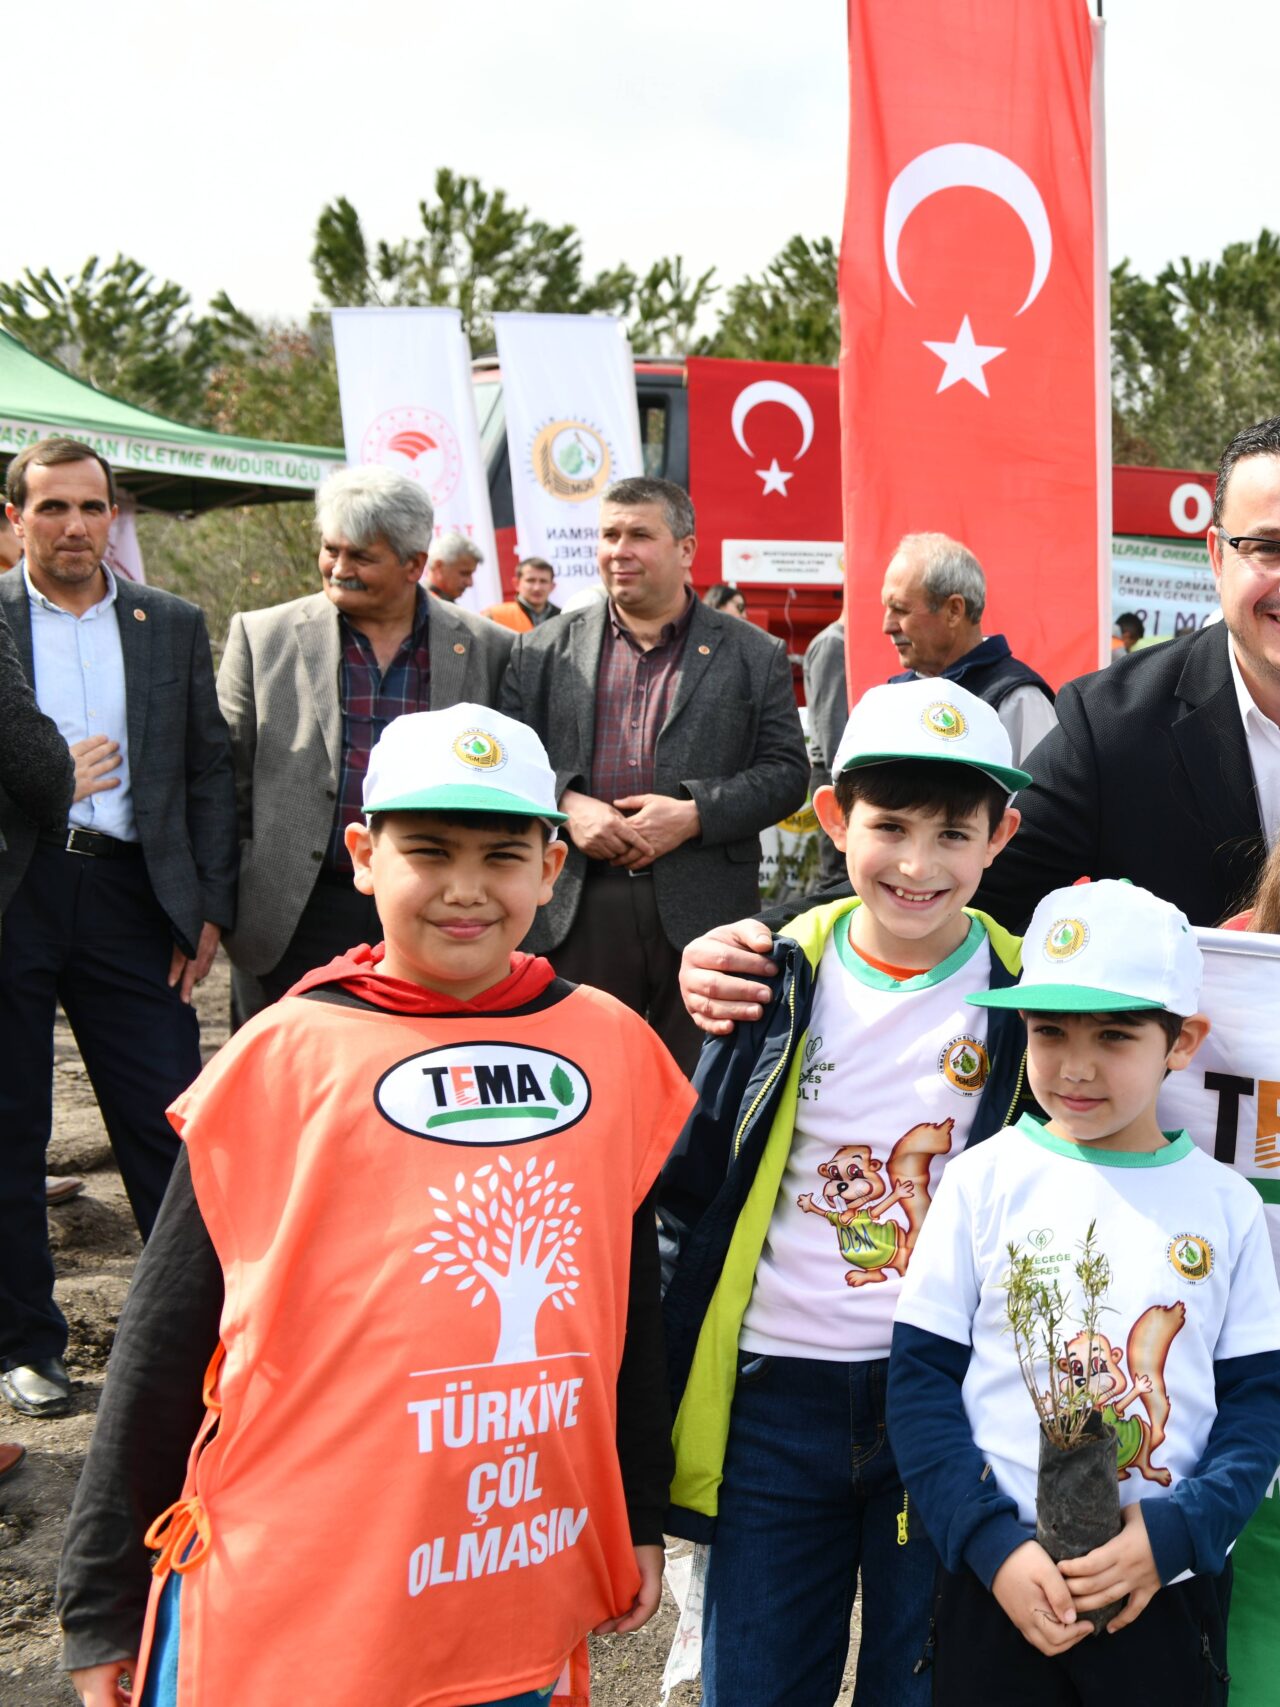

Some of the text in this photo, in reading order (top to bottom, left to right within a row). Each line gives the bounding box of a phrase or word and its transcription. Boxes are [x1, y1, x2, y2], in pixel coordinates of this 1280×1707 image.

[125, 440, 204, 469] İŞLETME
[210, 453, 321, 480] MÜDÜRLÜĞÜ
[422, 1063, 546, 1107] TEMA
[407, 1370, 584, 1454] TÜRKİYE
[467, 1442, 543, 1527] ÇÖL
[408, 1507, 588, 1598] OLMASIN
